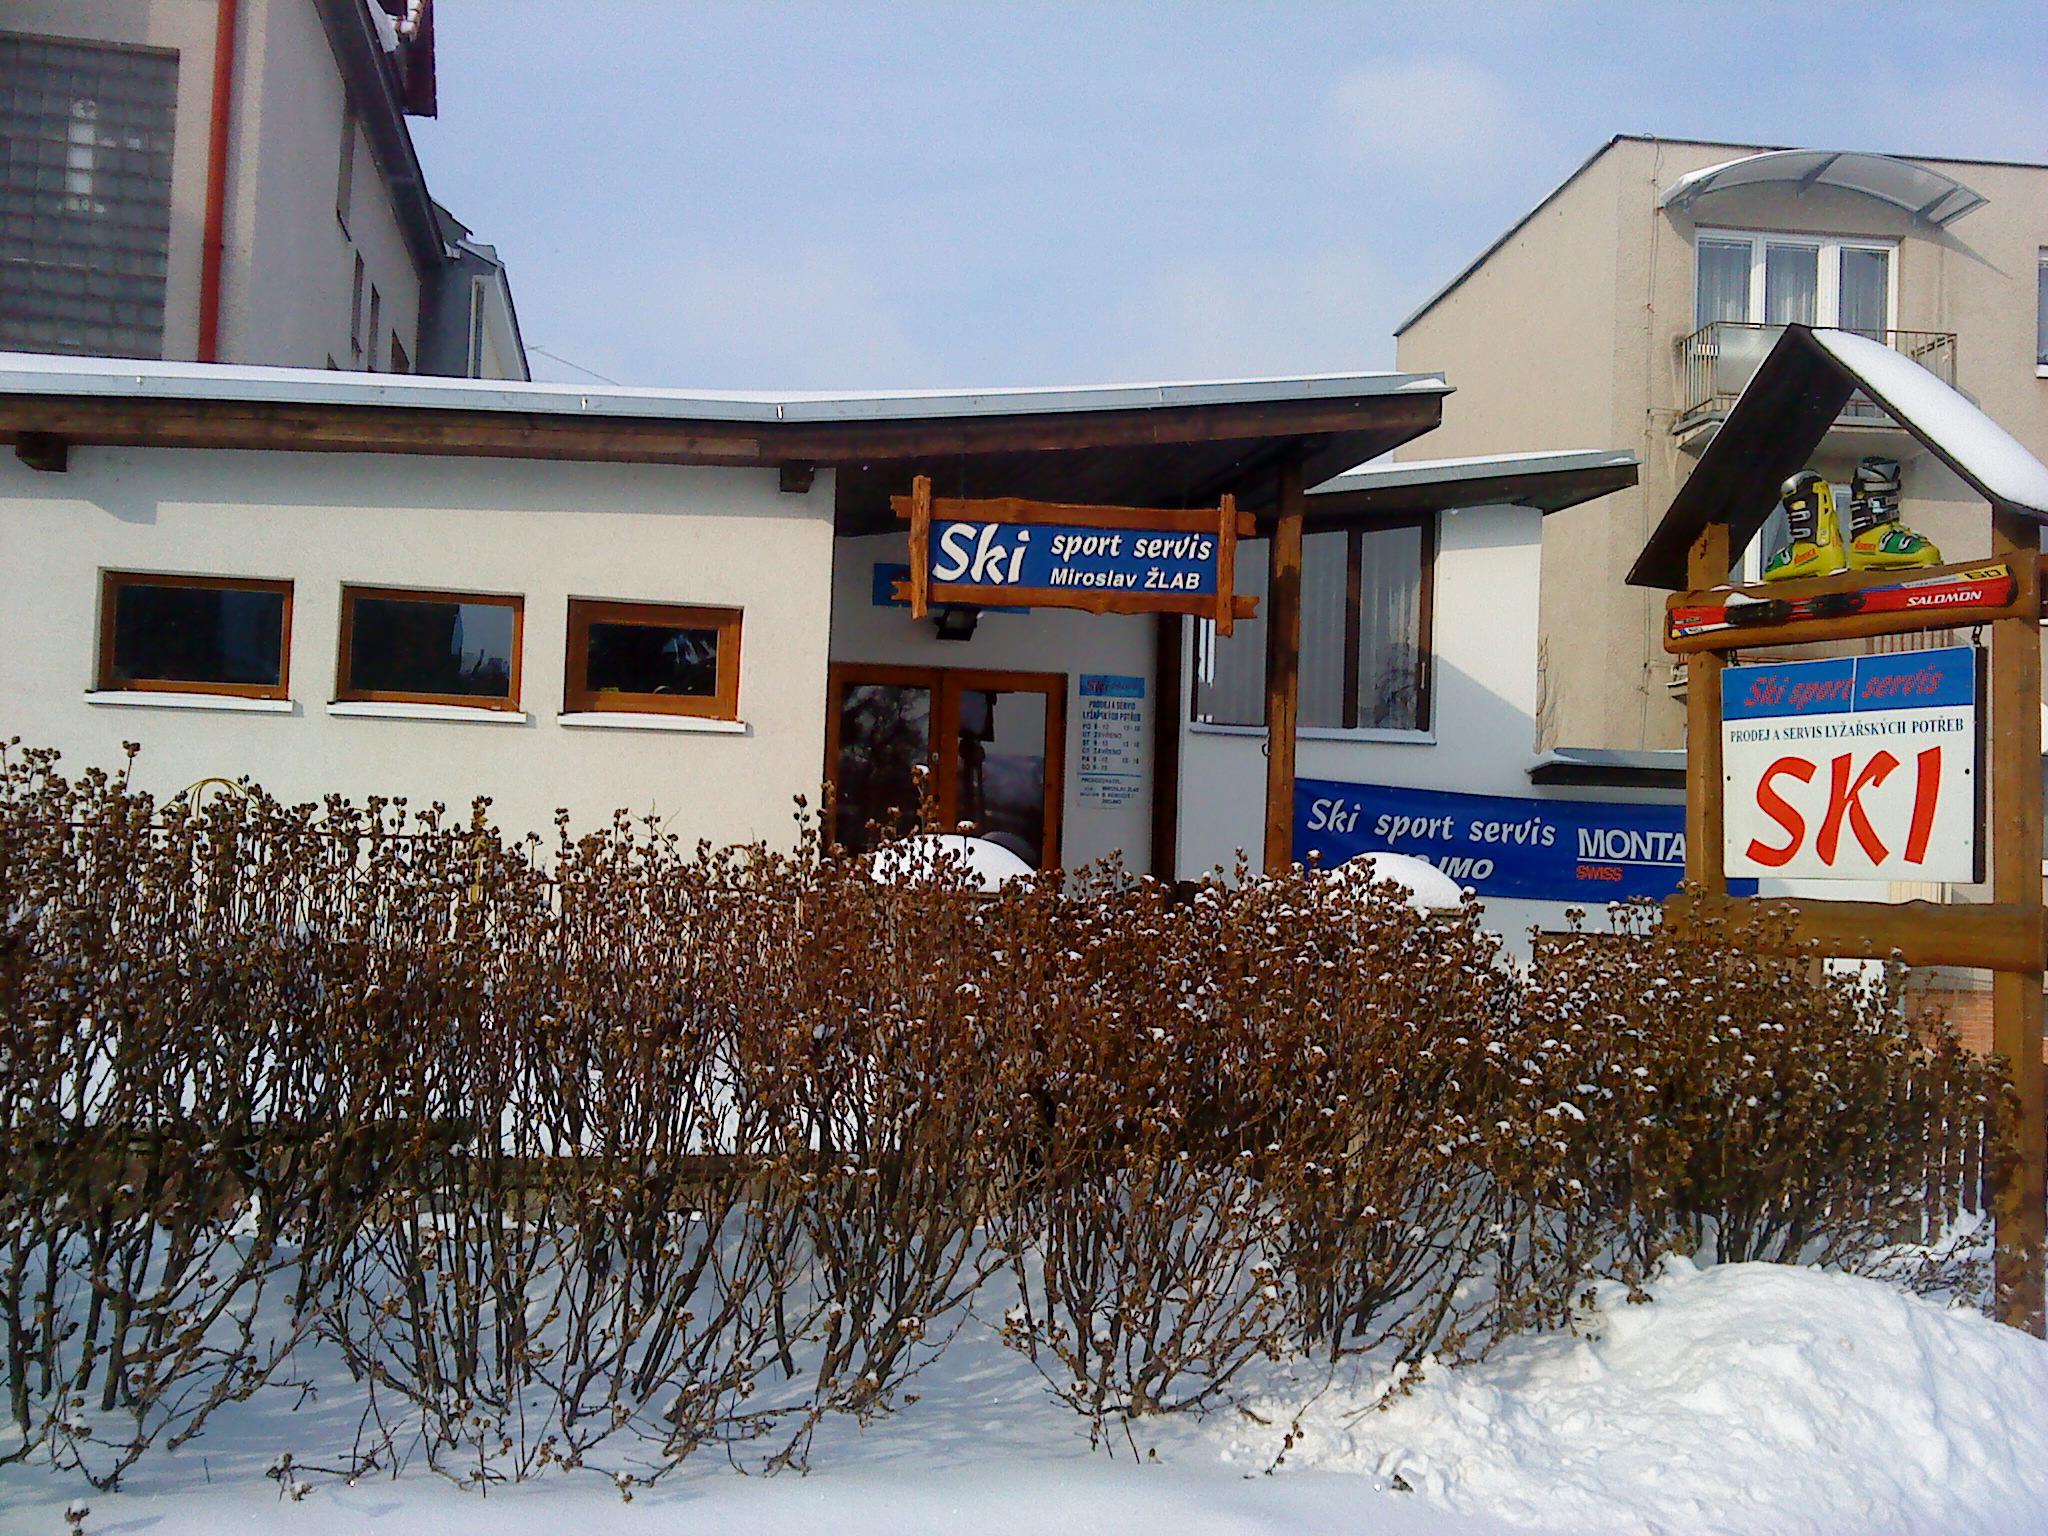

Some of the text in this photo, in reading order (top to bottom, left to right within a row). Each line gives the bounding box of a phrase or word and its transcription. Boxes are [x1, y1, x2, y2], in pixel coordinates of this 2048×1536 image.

[932, 523, 1213, 585] Ski sport servis
[1050, 567, 1201, 590] Miroslav ŽLAB
[1906, 590, 1982, 607] SALOMON
[1744, 664, 1944, 711] Ski sport servis
[1730, 715, 1964, 743] PRODEJ A SERVIS LYŽAŘSKÝCH POTŘEB
[1306, 799, 1361, 833] Ski
[1374, 814, 1454, 846] sport
[1469, 817, 1556, 846] servis
[1745, 745, 1942, 867] SKI
[1576, 865, 1624, 882] SWISS
